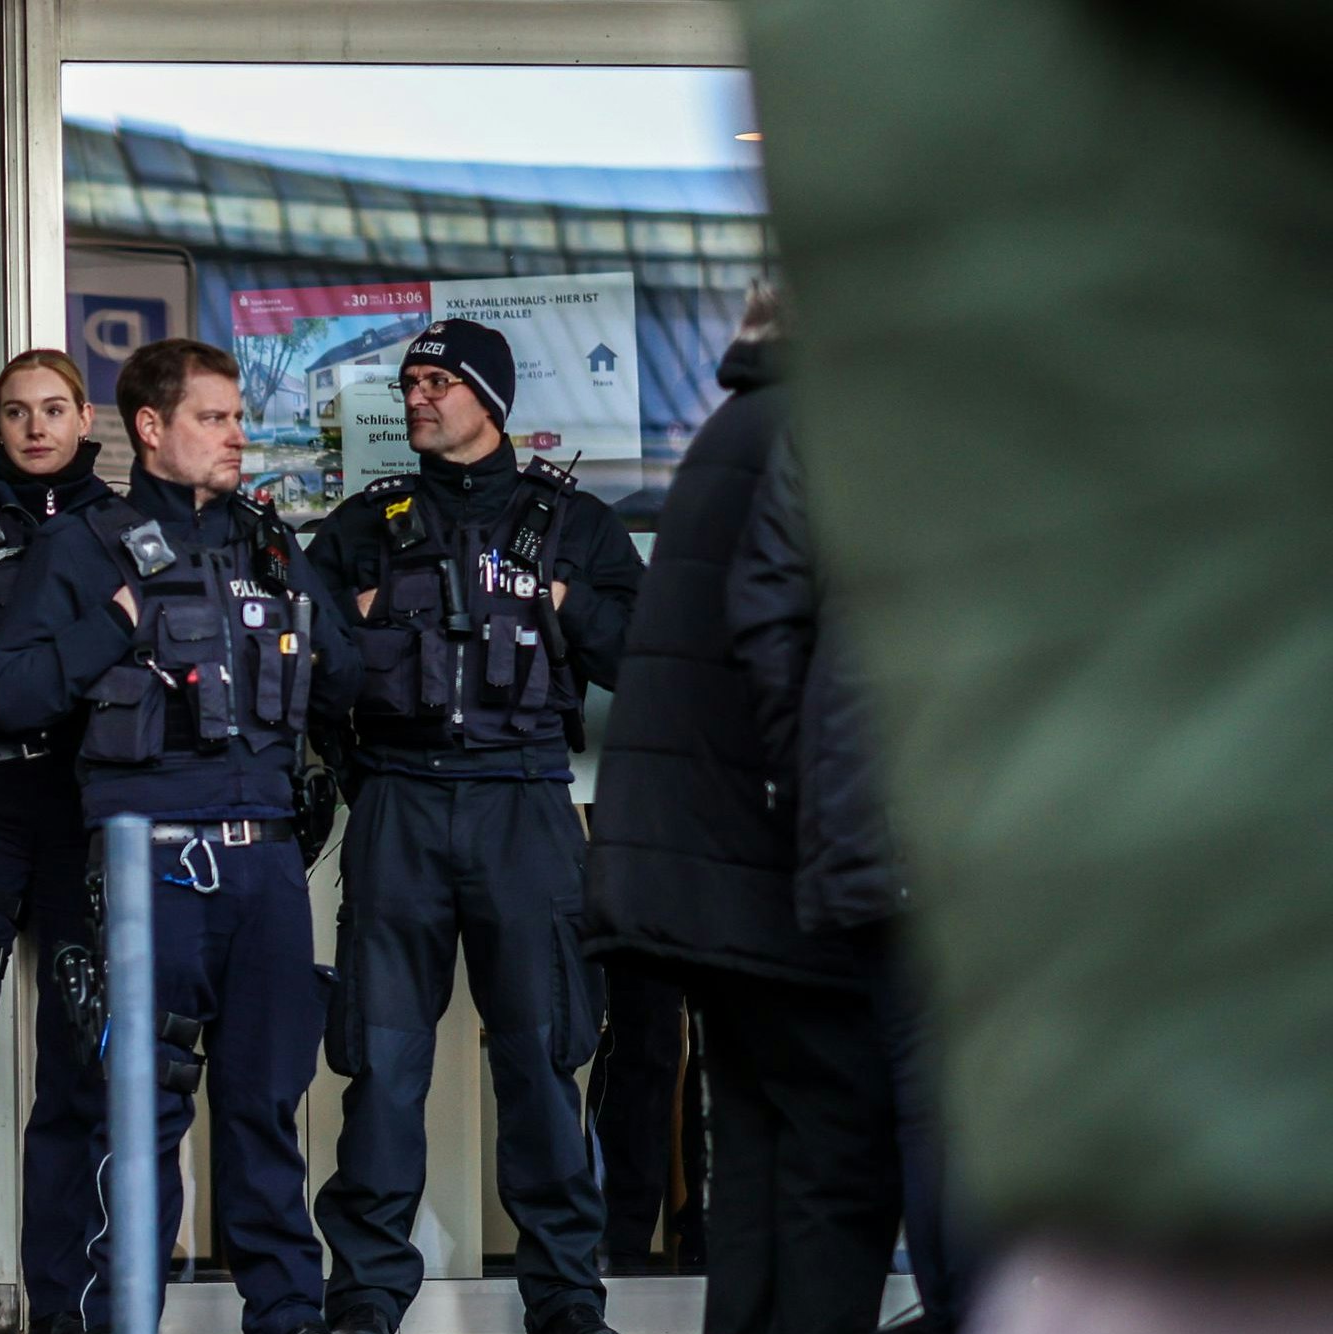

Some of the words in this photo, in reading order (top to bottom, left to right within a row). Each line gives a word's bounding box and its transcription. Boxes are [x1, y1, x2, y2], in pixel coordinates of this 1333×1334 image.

[351, 294, 367, 306] 30
[387, 292, 423, 305] 13:06
[446, 296, 546, 309] XXL-FAMILIENHAUS
[555, 294, 580, 304] HIER
[583, 293, 599, 302] IST
[480, 309, 501, 320] FÜR
[503, 309, 532, 319] ALLE!
[356, 414, 406, 425] Schlüsse
[369, 431, 408, 443] gefund
